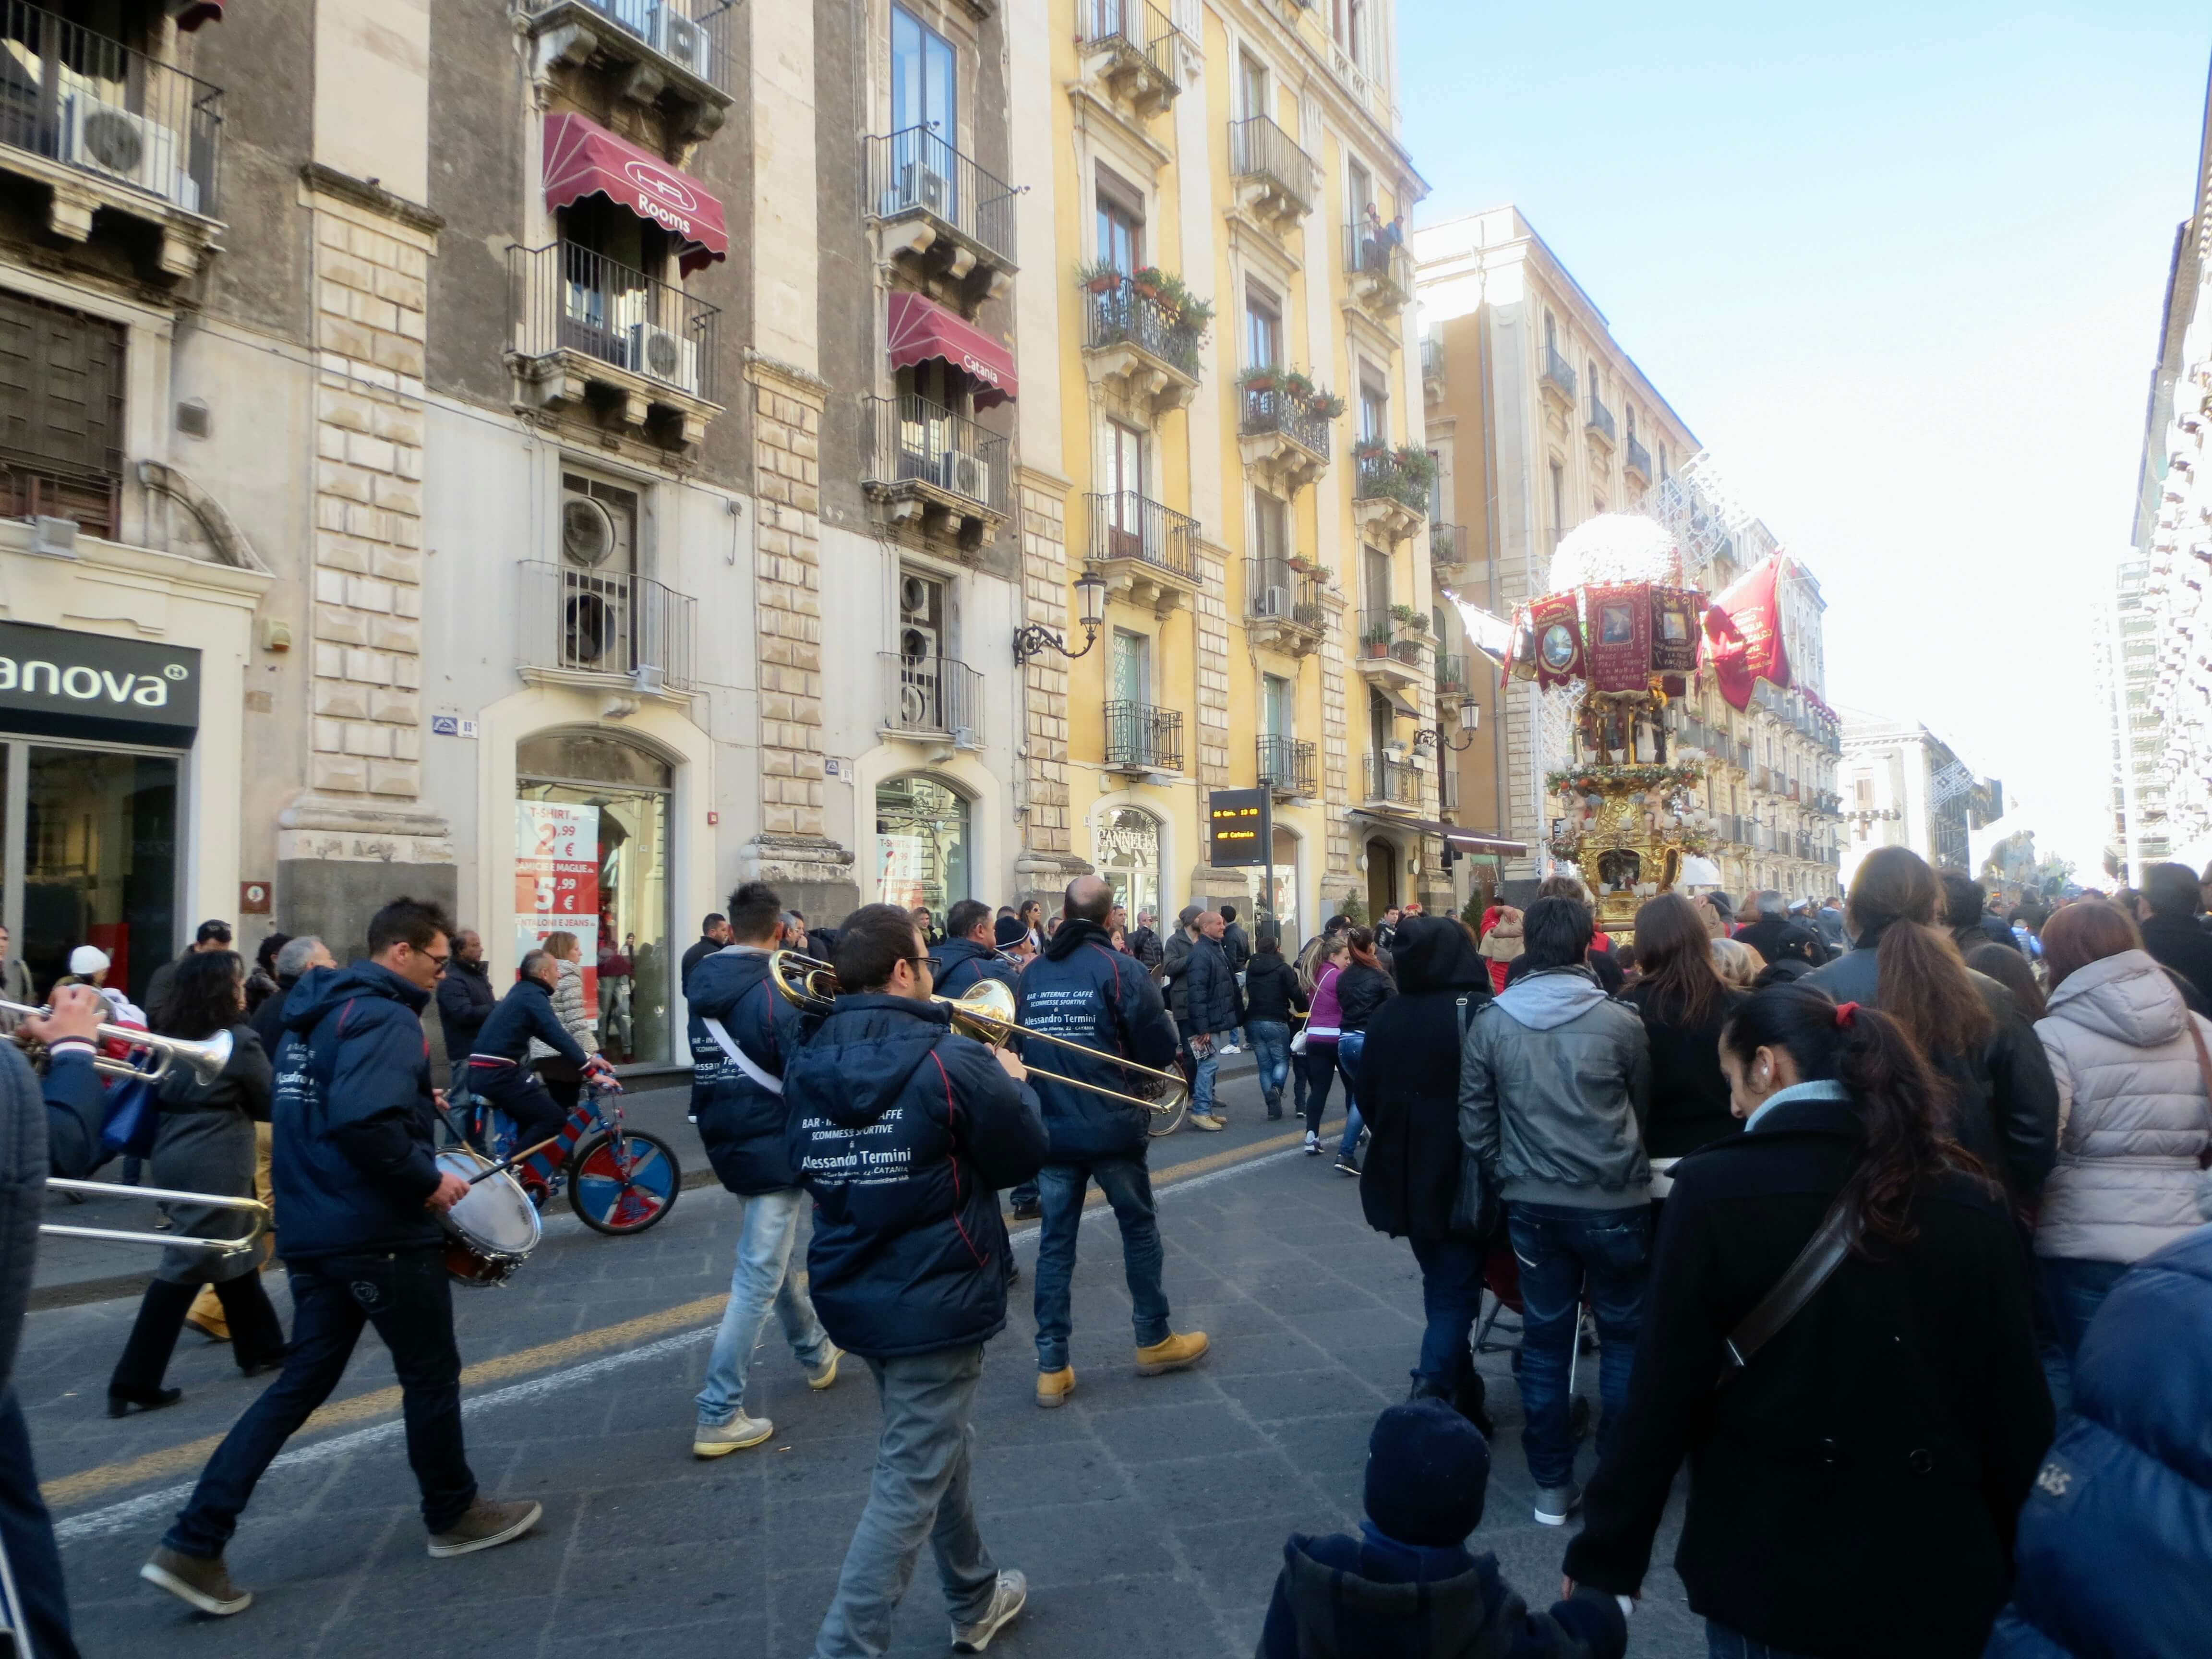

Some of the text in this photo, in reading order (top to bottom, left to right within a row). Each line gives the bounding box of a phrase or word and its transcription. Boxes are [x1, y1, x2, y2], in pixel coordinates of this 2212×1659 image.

[638, 193, 691, 234] Rooms
[963, 354, 998, 384] Catania
[530, 807, 570, 819] T-SHIRT
[1097, 829, 1159, 851] CANNELLA
[565, 919, 589, 927] JEANS
[1031, 999, 1058, 1008] SCOMMESSE
[1024, 1013, 1096, 1026] Alessandro Termini
[878, 1107, 903, 1120] AFFÈ
[802, 1118, 820, 1129] BAR
[802, 1147, 911, 1169] Alessandro Termini
